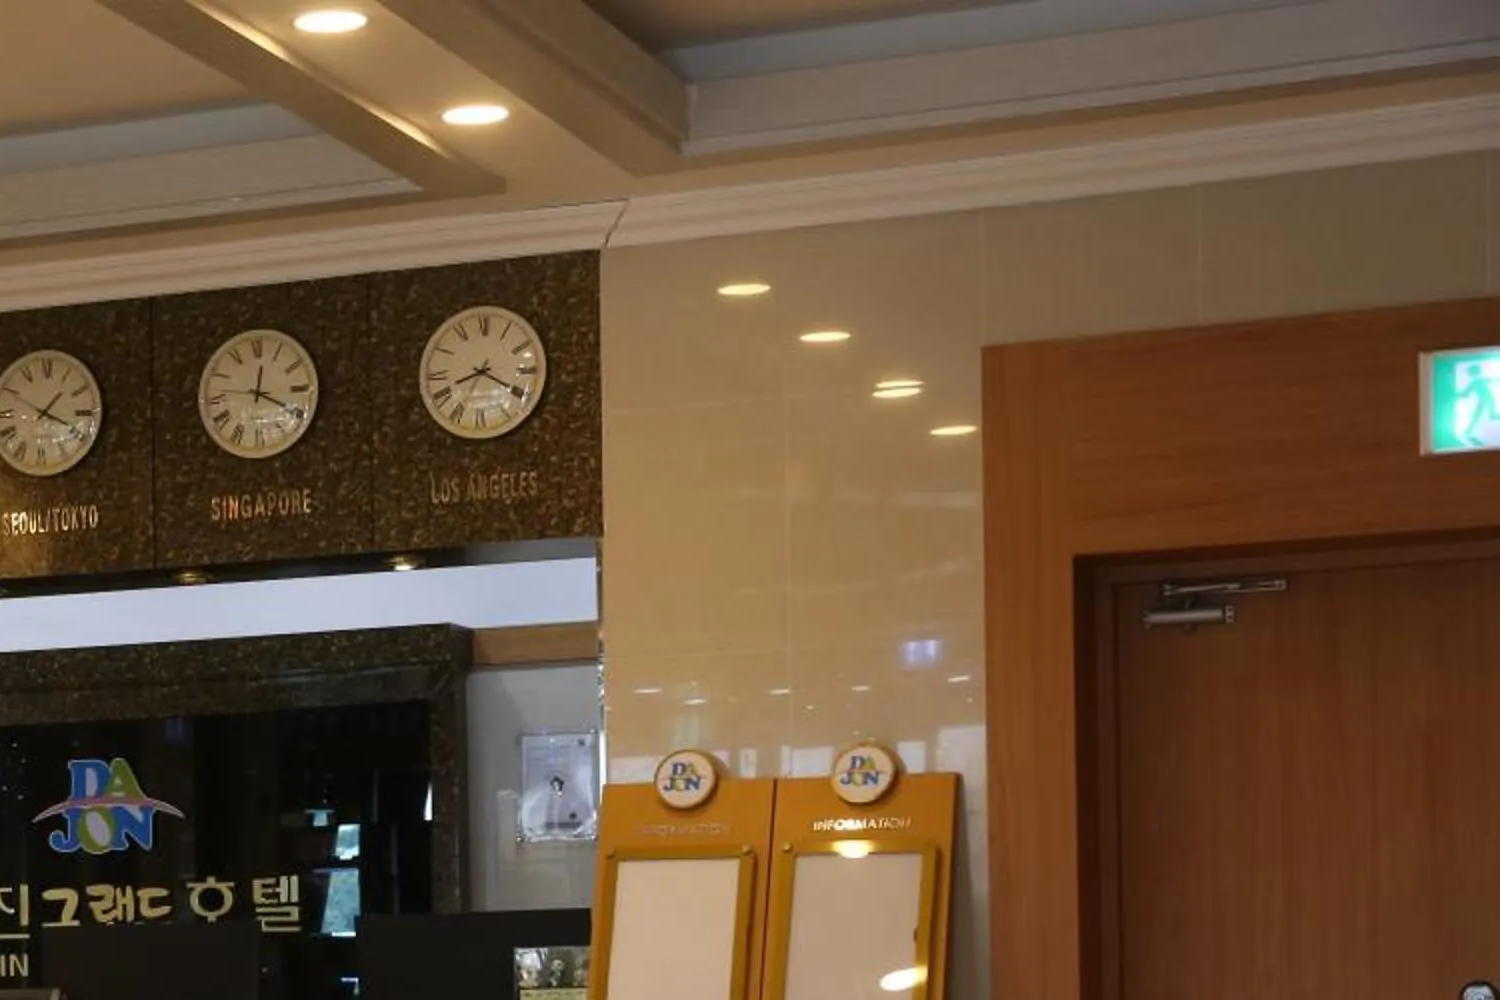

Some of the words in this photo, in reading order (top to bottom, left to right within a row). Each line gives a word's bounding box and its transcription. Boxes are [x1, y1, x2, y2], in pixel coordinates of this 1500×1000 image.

[430, 473, 460, 504] LOS
[466, 470, 539, 502] ANGELES
[210, 489, 312, 522] SINGAPORE
[812, 816, 912, 832] INFORMATION
